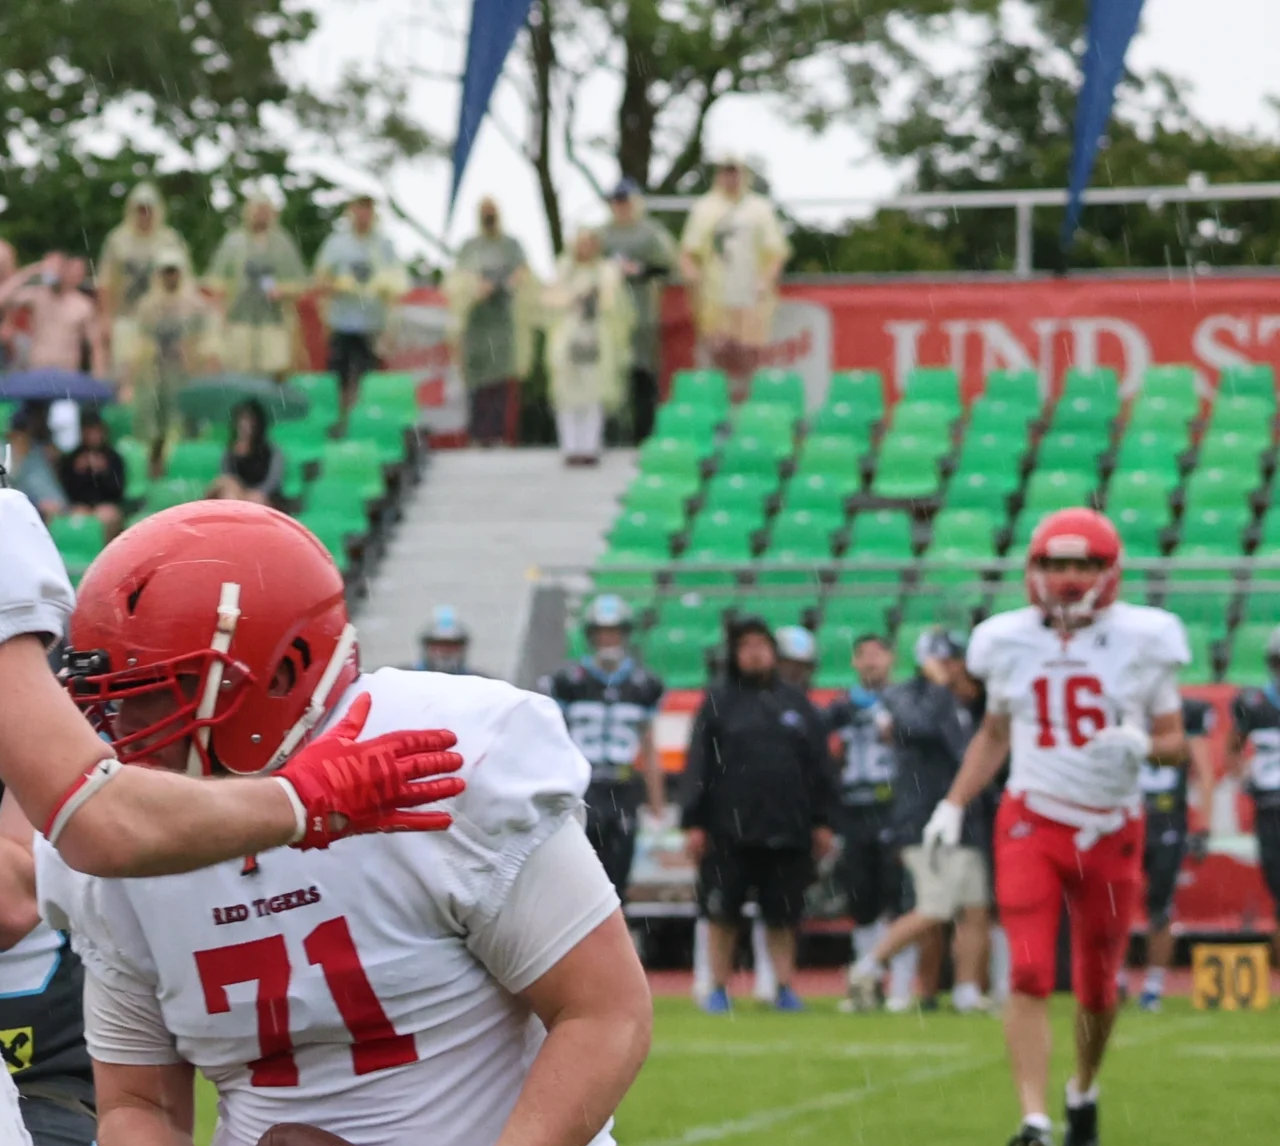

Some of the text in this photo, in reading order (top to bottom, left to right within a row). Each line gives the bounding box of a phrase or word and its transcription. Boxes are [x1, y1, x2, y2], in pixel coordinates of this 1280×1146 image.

[1031, 674, 1107, 749] 16
[213, 885, 322, 925] RED TIGERS
[193, 914, 419, 1088] 71
[1203, 954, 1258, 1009] 30
